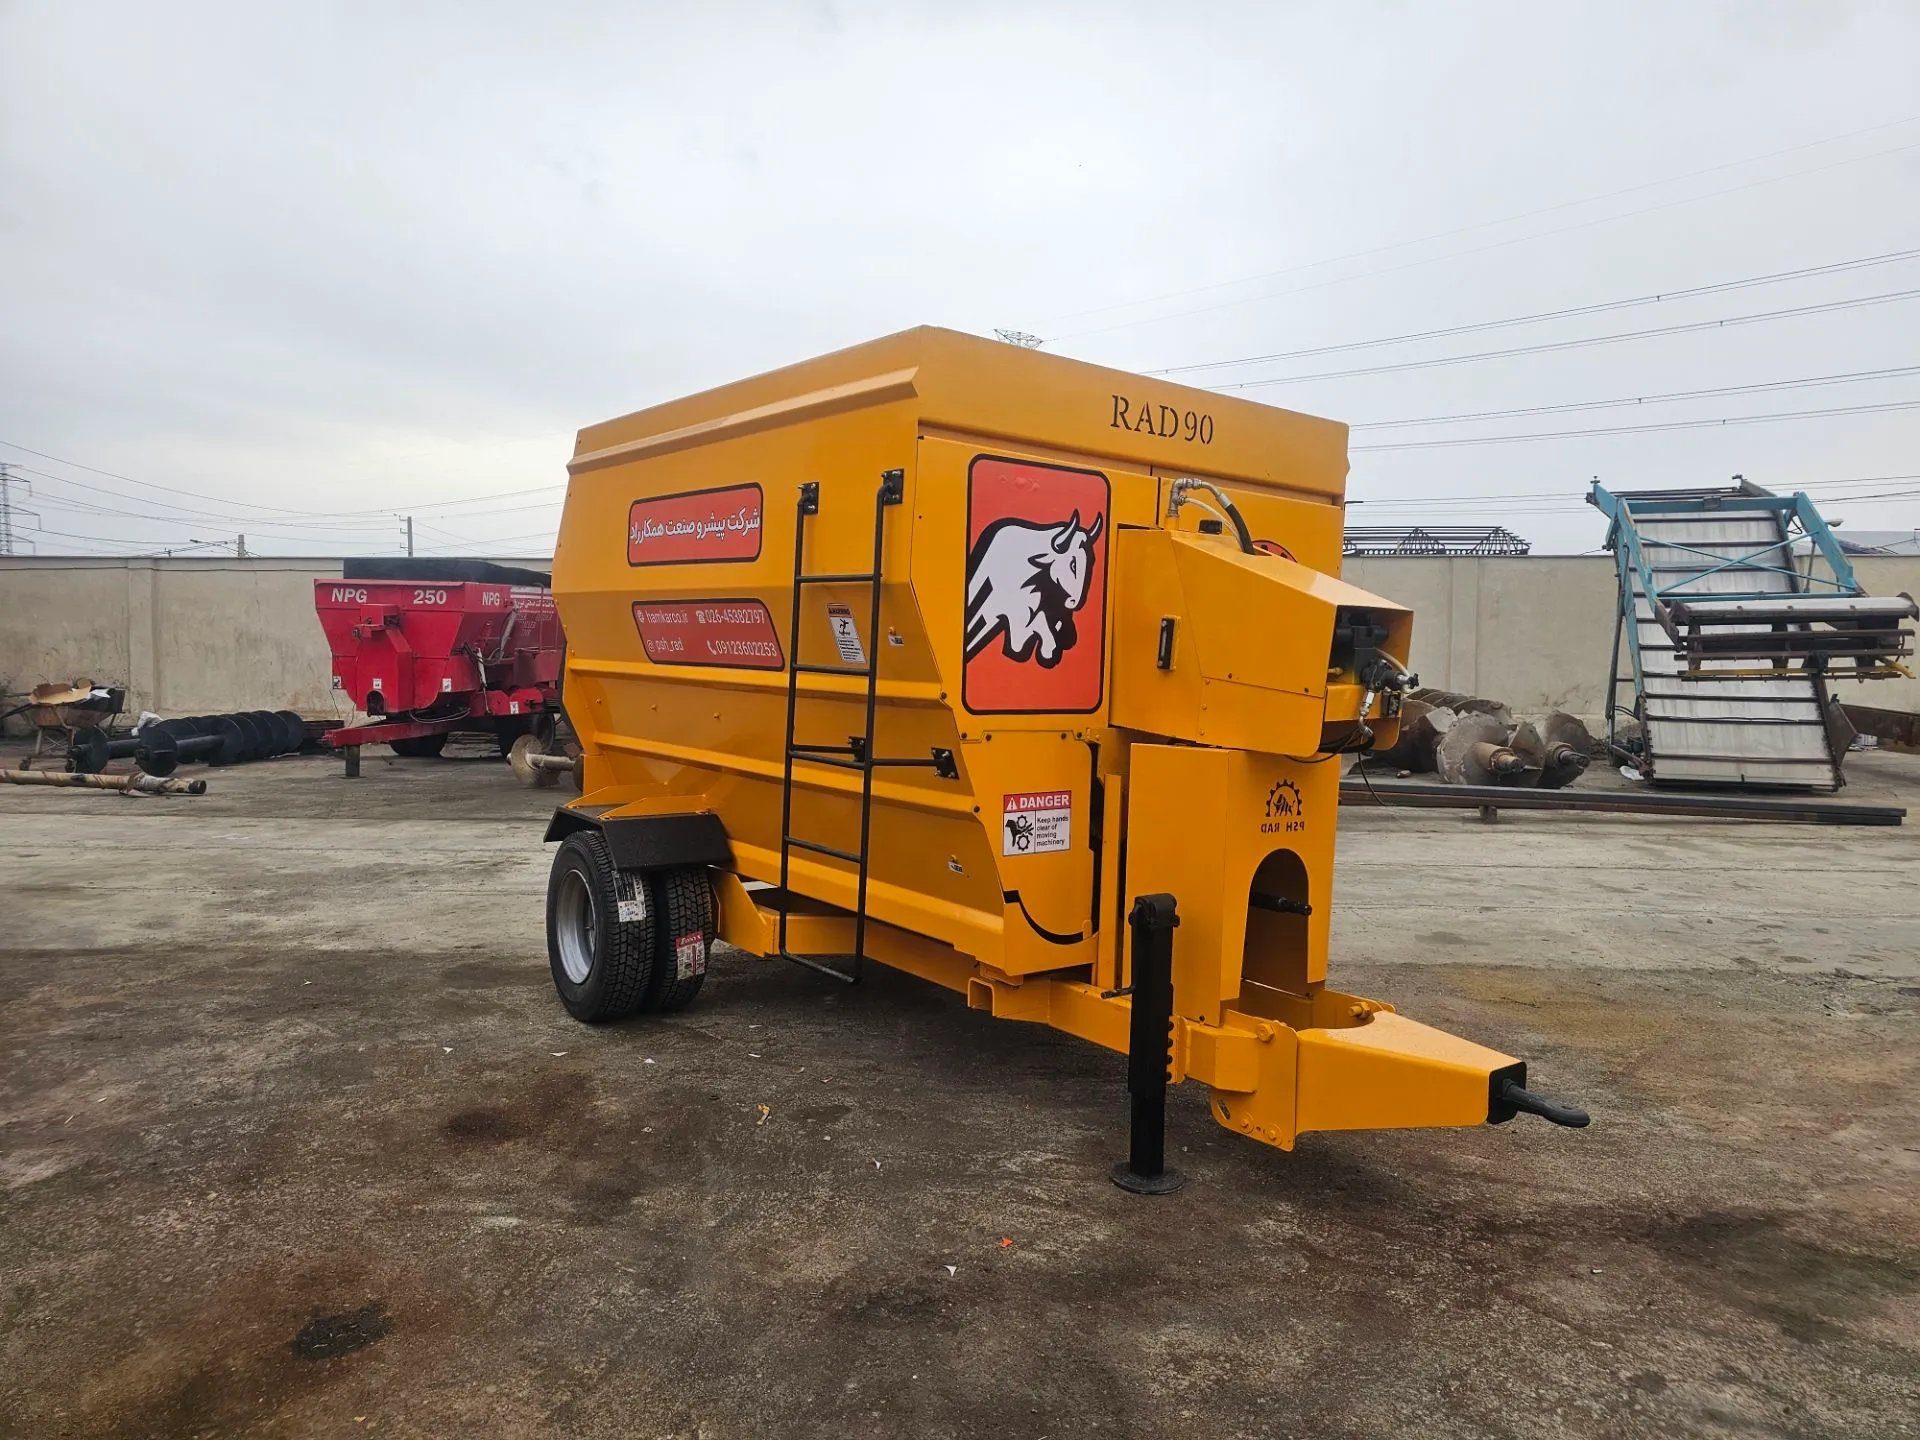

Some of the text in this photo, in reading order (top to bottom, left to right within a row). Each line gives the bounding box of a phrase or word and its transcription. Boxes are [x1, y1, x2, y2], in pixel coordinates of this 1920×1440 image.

[1110, 394, 1214, 445] RAD 90
[665, 519, 695, 536] صنعت
[697, 511, 725, 540] پیشرو
[727, 507, 760, 536] شرکت
[331, 588, 368, 604] NPG
[413, 589, 447, 605] 250
[482, 591, 501, 606] NPG
[715, 640, 777, 657] 09123602253
[1019, 794, 1070, 809] DANGER
[1036, 815, 1069, 824] Keep hands
[1051, 823, 1058, 831] of
[1036, 839, 1065, 847] machinery
